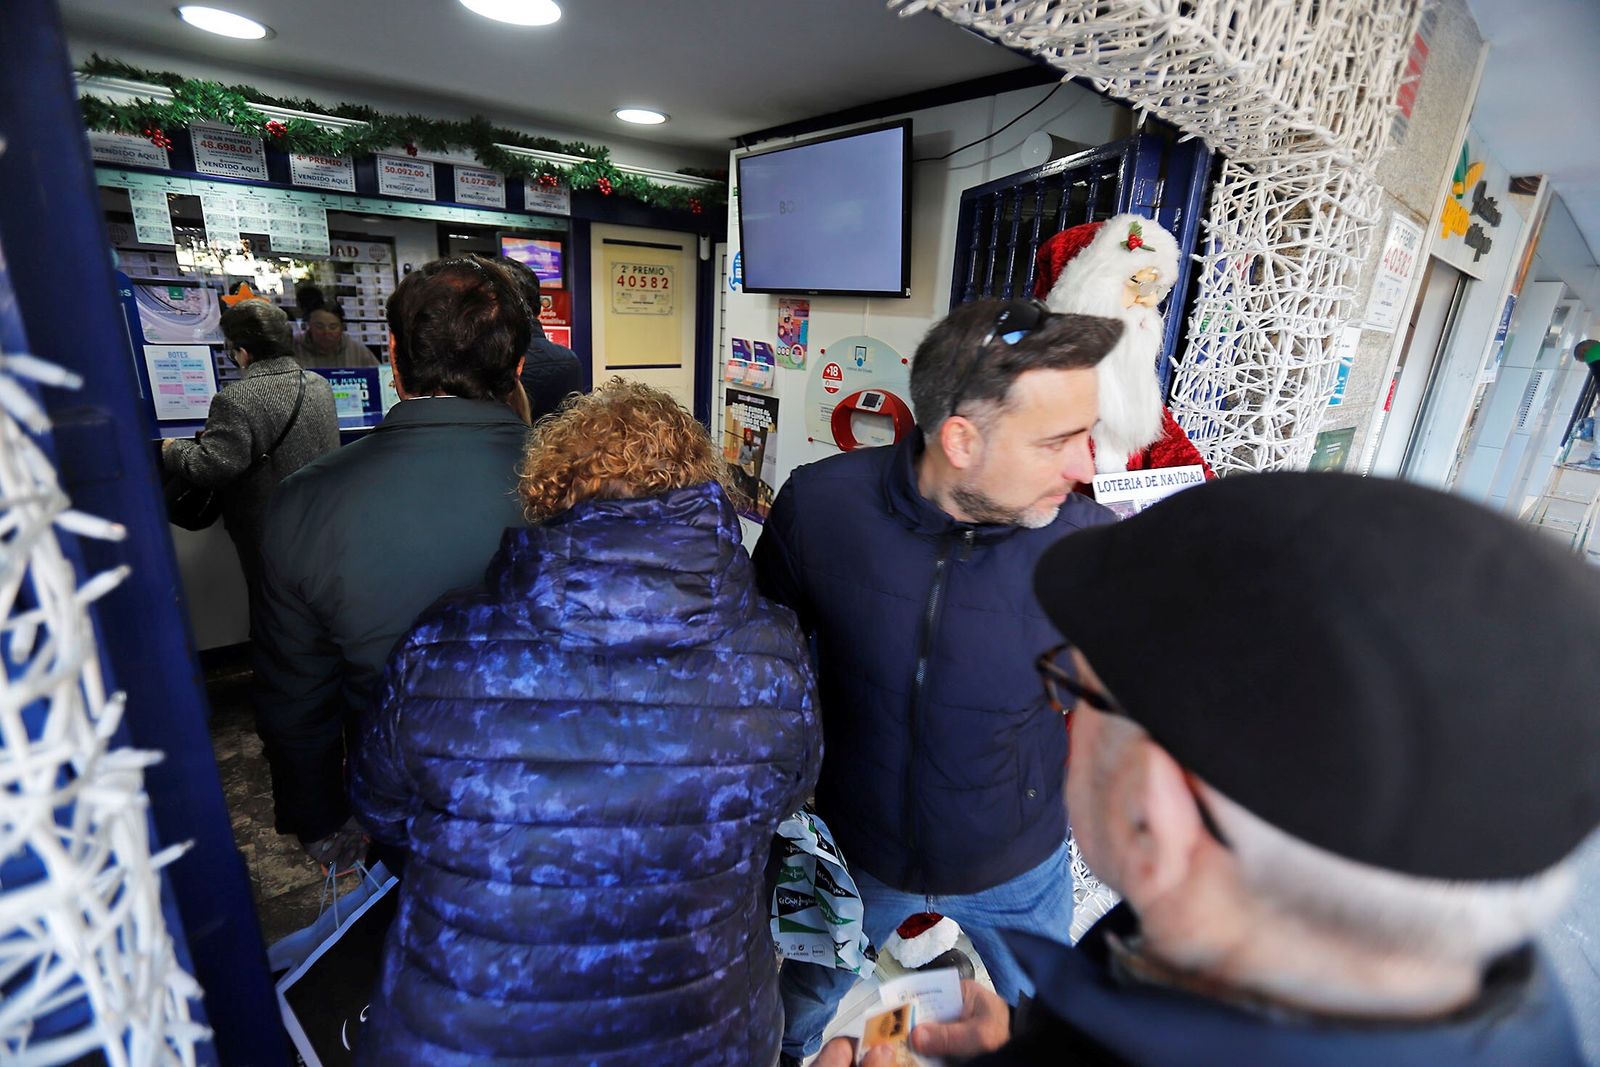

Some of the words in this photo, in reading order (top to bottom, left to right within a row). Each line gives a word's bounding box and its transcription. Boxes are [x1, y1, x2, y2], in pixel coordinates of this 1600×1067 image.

[94, 146, 136, 158] VENDIDO
[200, 140, 252, 154] 48.698.00
[202, 160, 239, 170] VENDIDO
[309, 155, 343, 167] PREMIO
[297, 173, 330, 182] VENDIDO
[384, 165, 425, 178] 50.092.00
[385, 183, 414, 192] VENDIDO
[632, 265, 665, 276] PREMIO
[616, 274, 669, 290] 40582
[168, 351, 188, 359] BOTES
[825, 365, 840, 377] +18
[1096, 478, 1143, 493] LOTERIA
[1145, 475, 1160, 488] DE
[1160, 470, 1203, 486] NAVIDAD
